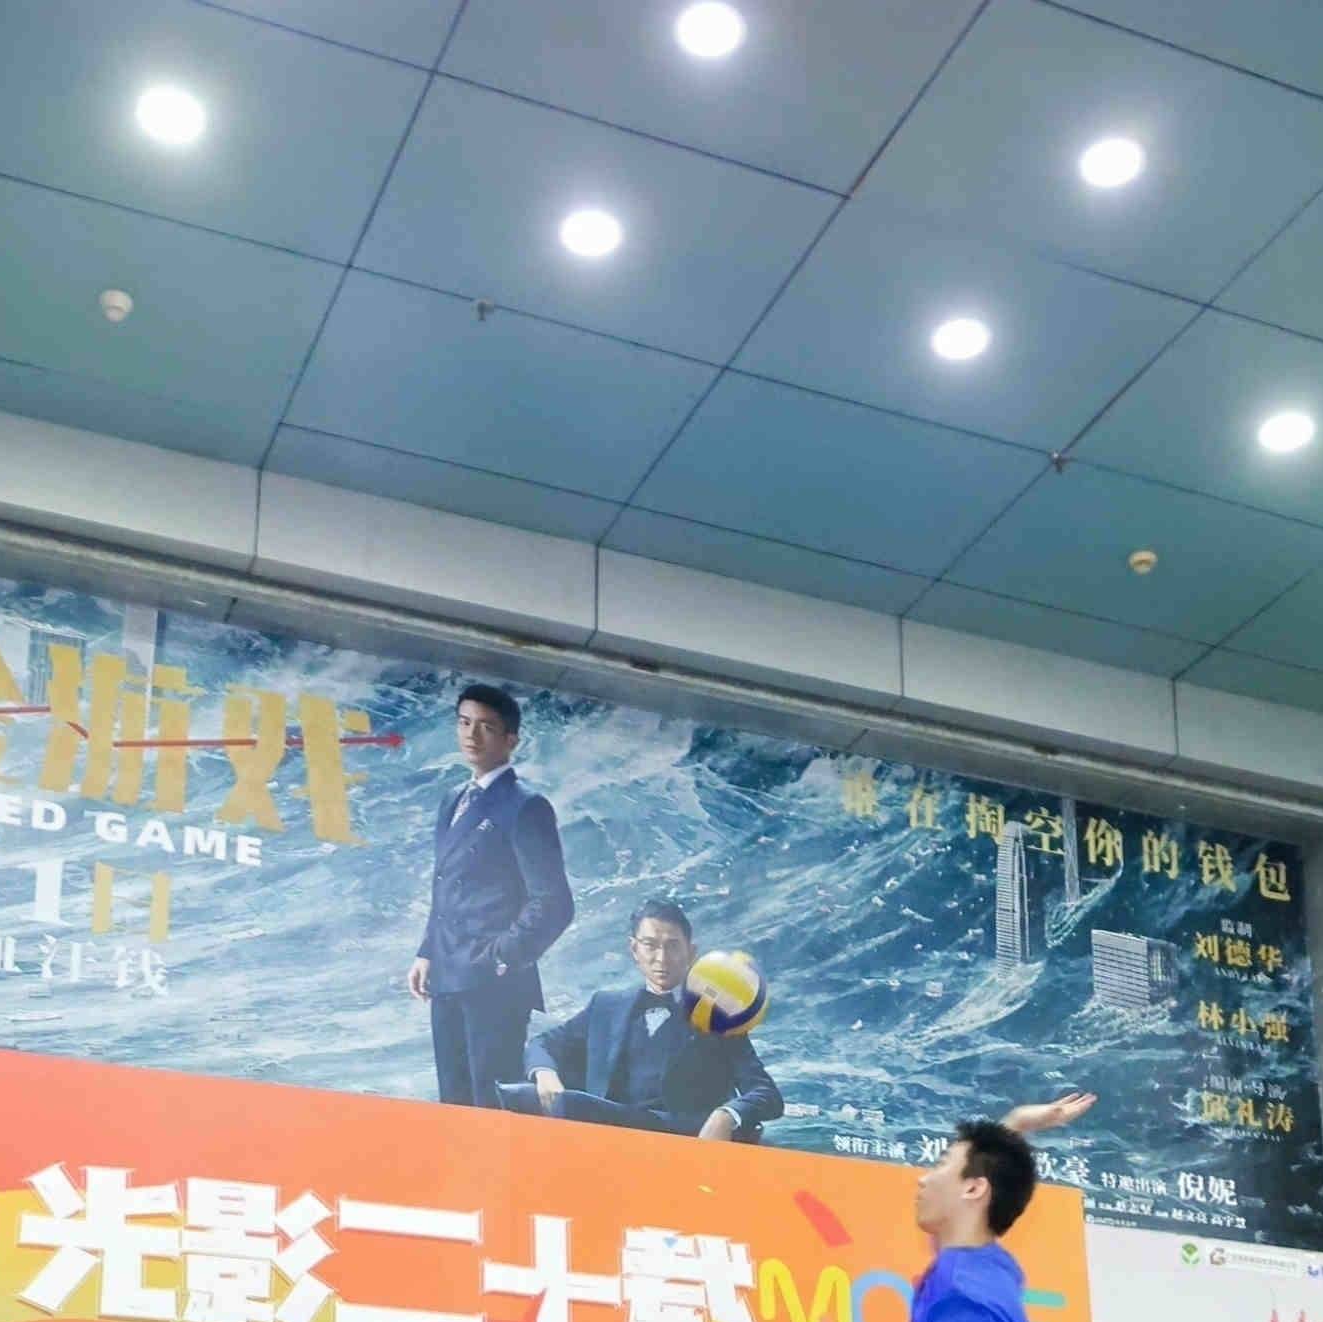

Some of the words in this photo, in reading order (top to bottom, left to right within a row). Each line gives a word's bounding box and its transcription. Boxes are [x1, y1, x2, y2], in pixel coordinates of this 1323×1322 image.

[94, 810, 263, 867] GAME
[1194, 931, 1283, 972] 刘德华
[1177, 1170, 1239, 1206] 倪妮
